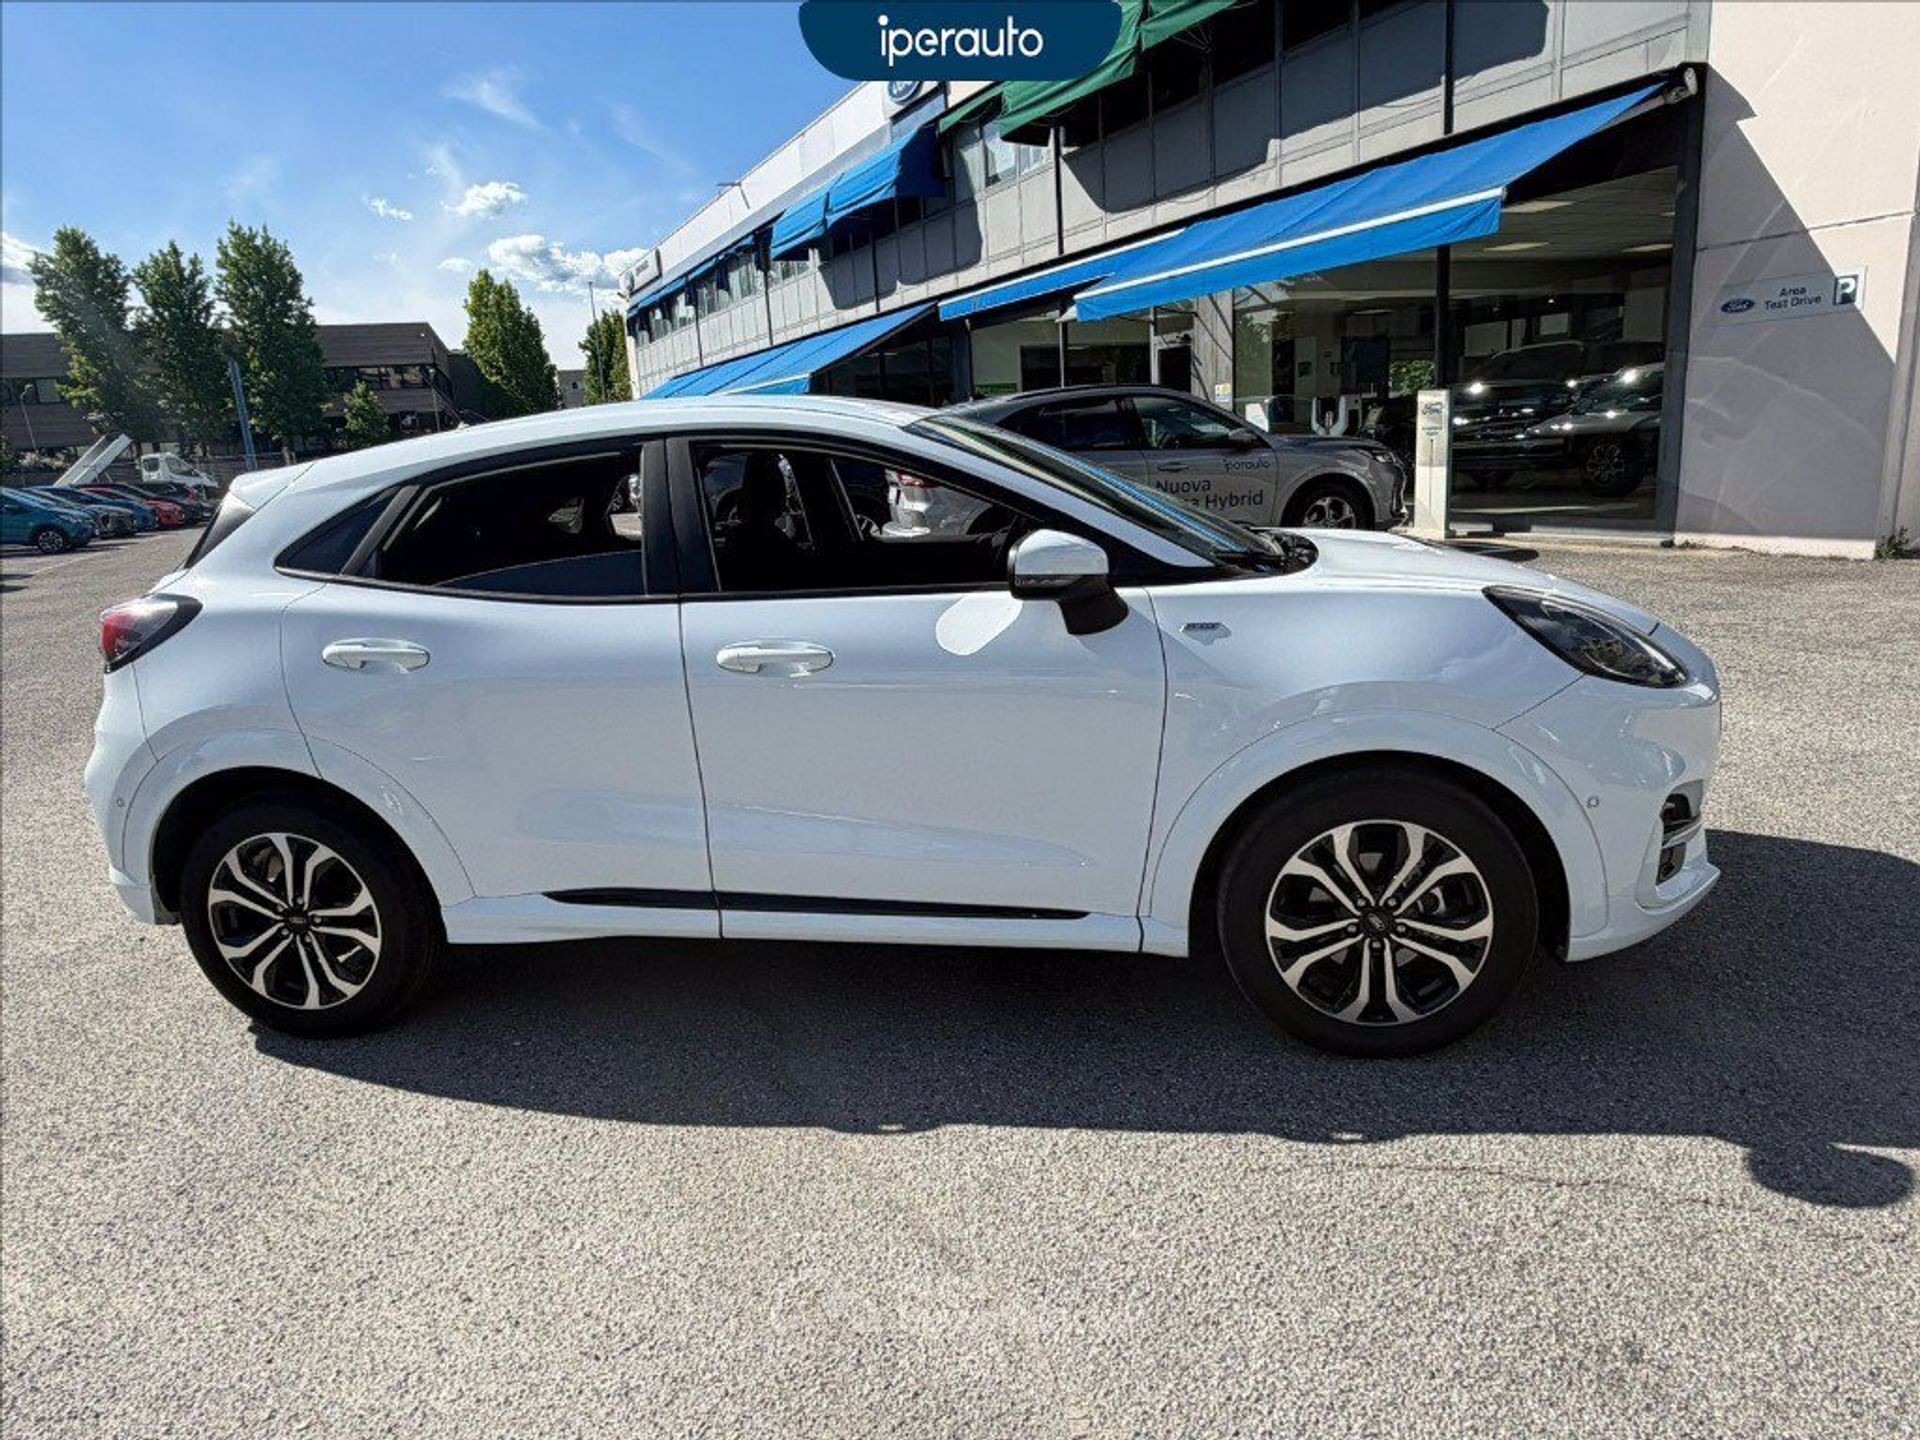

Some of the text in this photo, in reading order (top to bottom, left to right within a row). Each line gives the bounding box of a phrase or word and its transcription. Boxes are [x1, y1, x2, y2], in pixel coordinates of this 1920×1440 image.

[1779, 286, 1807, 298] Area
[1765, 295, 1822, 311] Test Drive
[1156, 480, 1212, 494] Nuova
[1205, 490, 1264, 511] Hybrid
